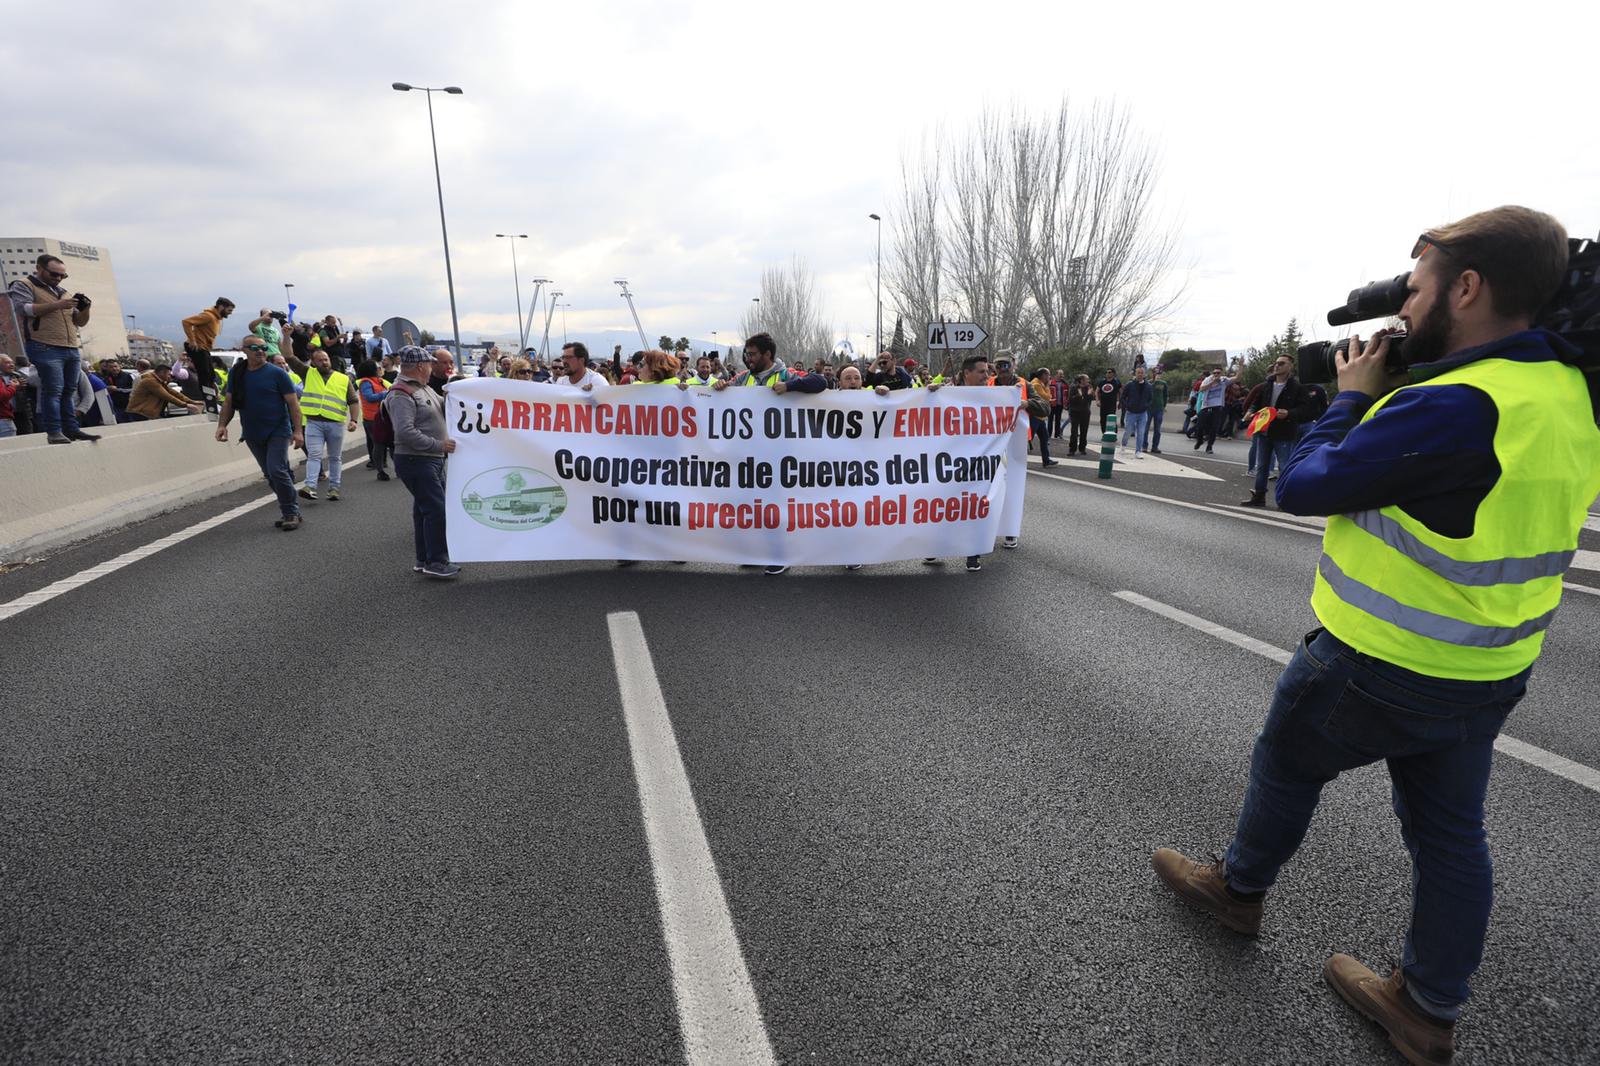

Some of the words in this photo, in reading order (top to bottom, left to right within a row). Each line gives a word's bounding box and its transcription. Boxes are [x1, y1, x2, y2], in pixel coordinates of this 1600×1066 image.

[954, 330, 974, 342] 129
[708, 407, 754, 440] LOS
[763, 407, 864, 440] OLIVOS
[872, 410, 888, 439] Y
[893, 405, 1022, 438] EMIGRAM
[554, 448, 731, 488] Cooperativa
[737, 456, 773, 489] de
[780, 455, 880, 489] Cuevas
[885, 453, 929, 485] del
[935, 451, 1002, 484] Camp
[592, 495, 639, 524] por
[645, 499, 681, 527] un
[688, 498, 781, 531] precio
[786, 497, 858, 532] justo
[864, 494, 907, 527] del
[913, 491, 990, 525] aceite
